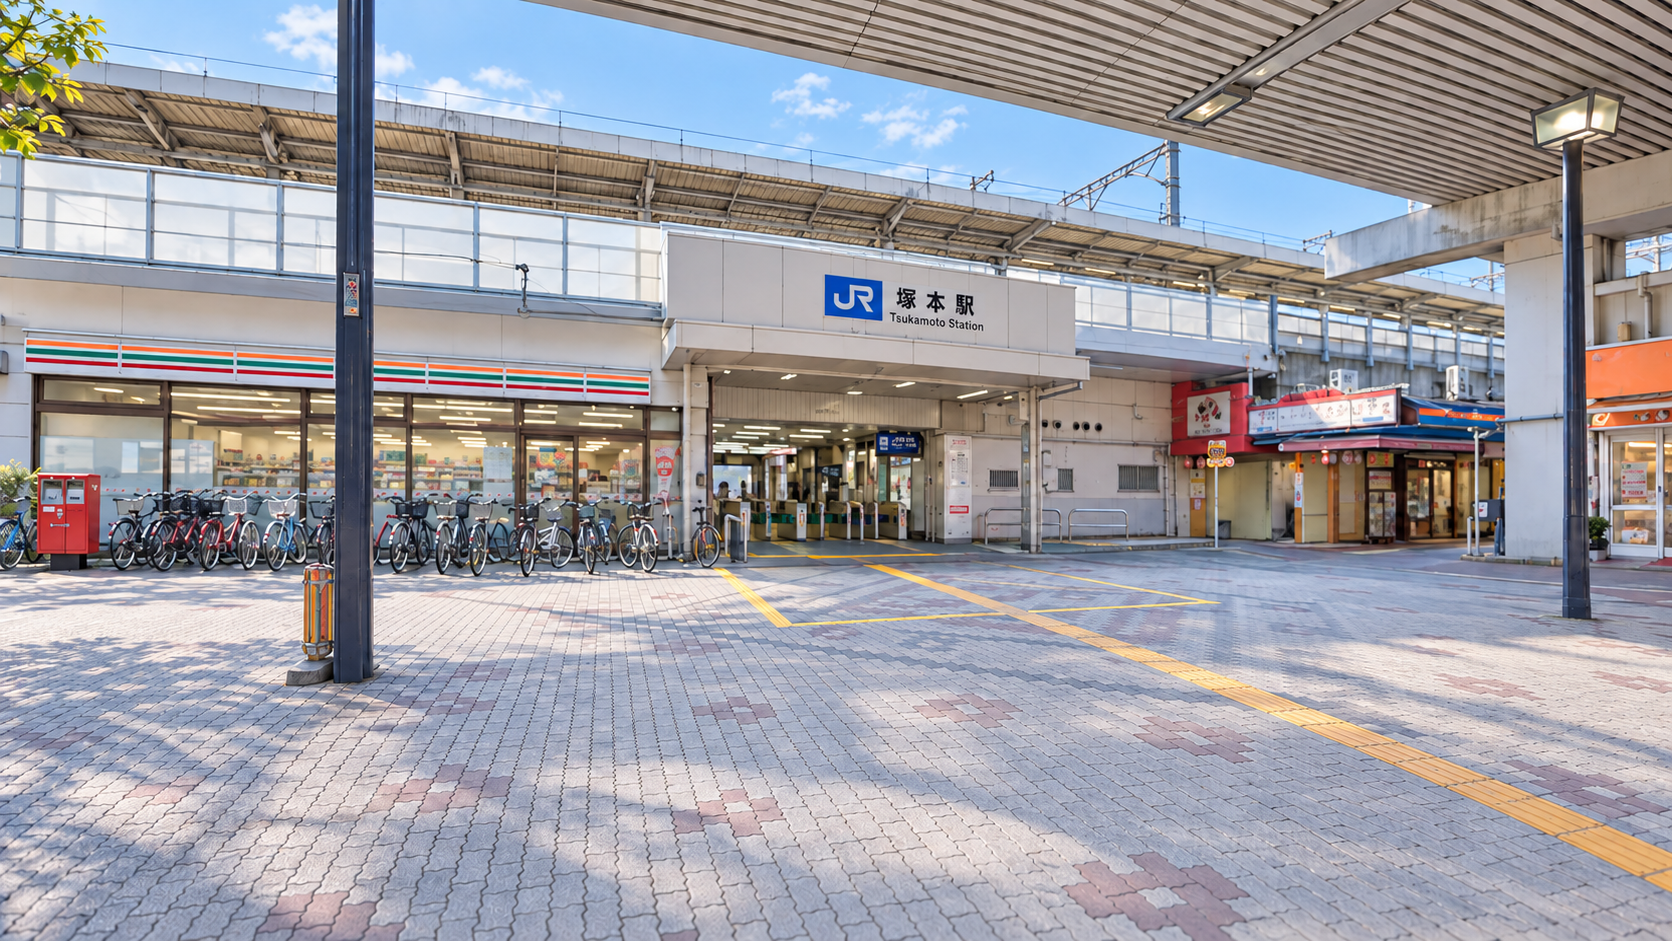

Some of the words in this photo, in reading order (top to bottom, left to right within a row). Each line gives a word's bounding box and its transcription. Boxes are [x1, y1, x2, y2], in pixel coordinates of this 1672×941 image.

[834, 284, 873, 313] JR
[896, 287, 974, 316] 塚本駅
[889, 311, 945, 327] Tsukamoto
[948, 318, 984, 331] Station
